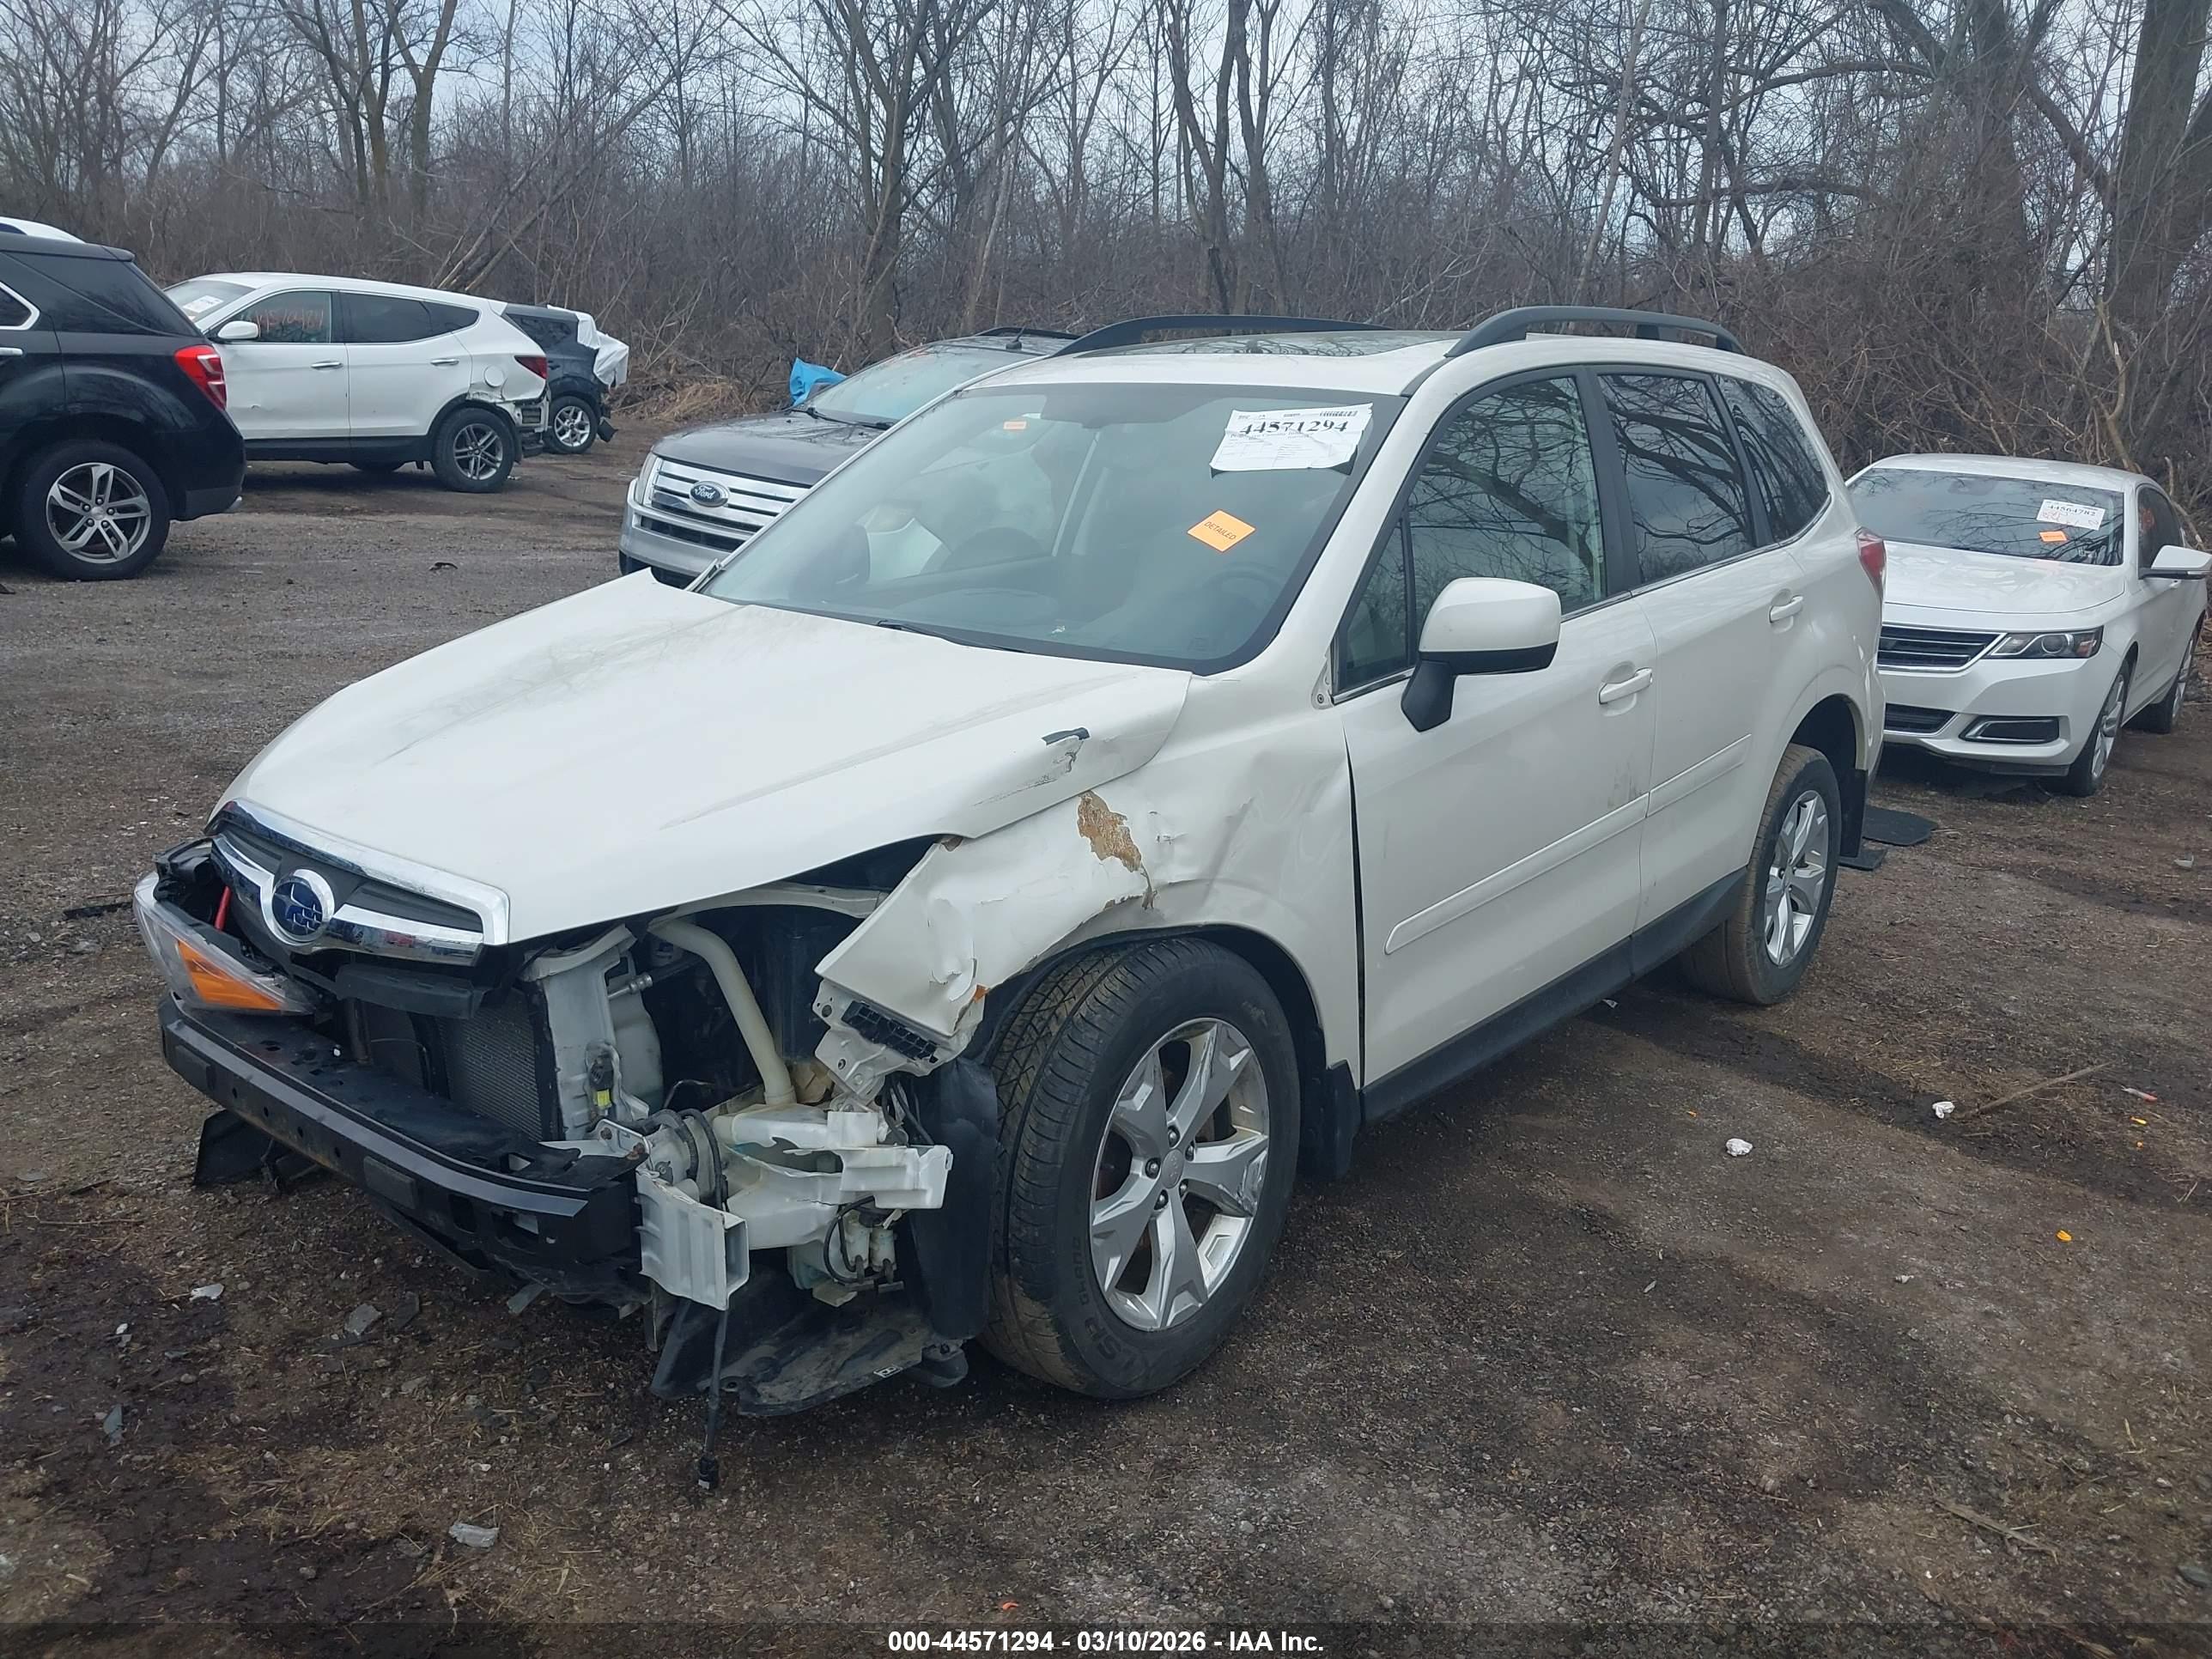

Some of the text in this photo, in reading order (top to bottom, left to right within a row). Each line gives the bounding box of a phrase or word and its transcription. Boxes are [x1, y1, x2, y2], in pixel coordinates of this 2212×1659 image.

[1239, 419, 1348, 435] 44571294
[695, 486, 716, 499] Ford
[1204, 520, 1237, 540] DETAILED
